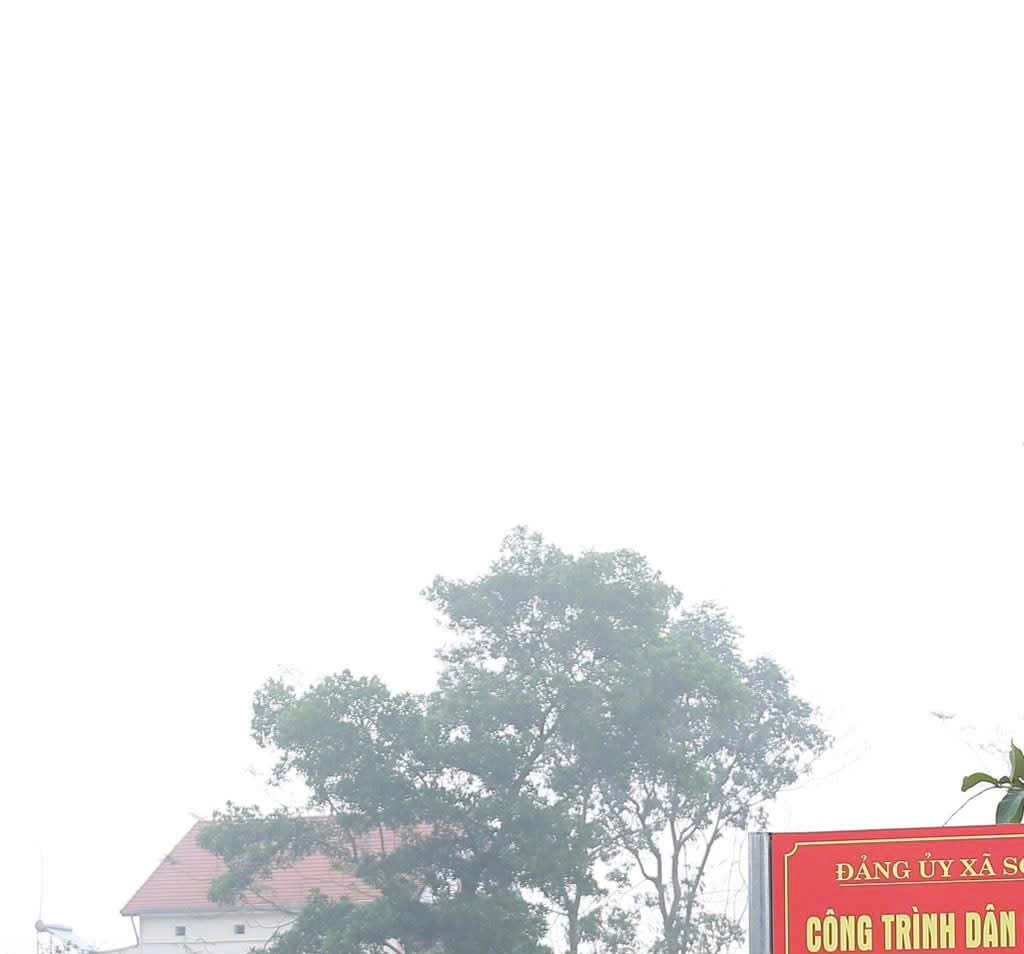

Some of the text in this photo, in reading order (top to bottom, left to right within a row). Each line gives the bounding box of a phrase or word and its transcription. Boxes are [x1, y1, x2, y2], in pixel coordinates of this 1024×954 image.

[835, 854, 912, 881] ĐẢNG
[918, 852, 954, 878] ỦY
[960, 853, 996, 877] XÃ
[806, 908, 873, 953] CÔNG
[880, 905, 956, 951] TRÌNH
[965, 903, 1017, 949] DÂN
